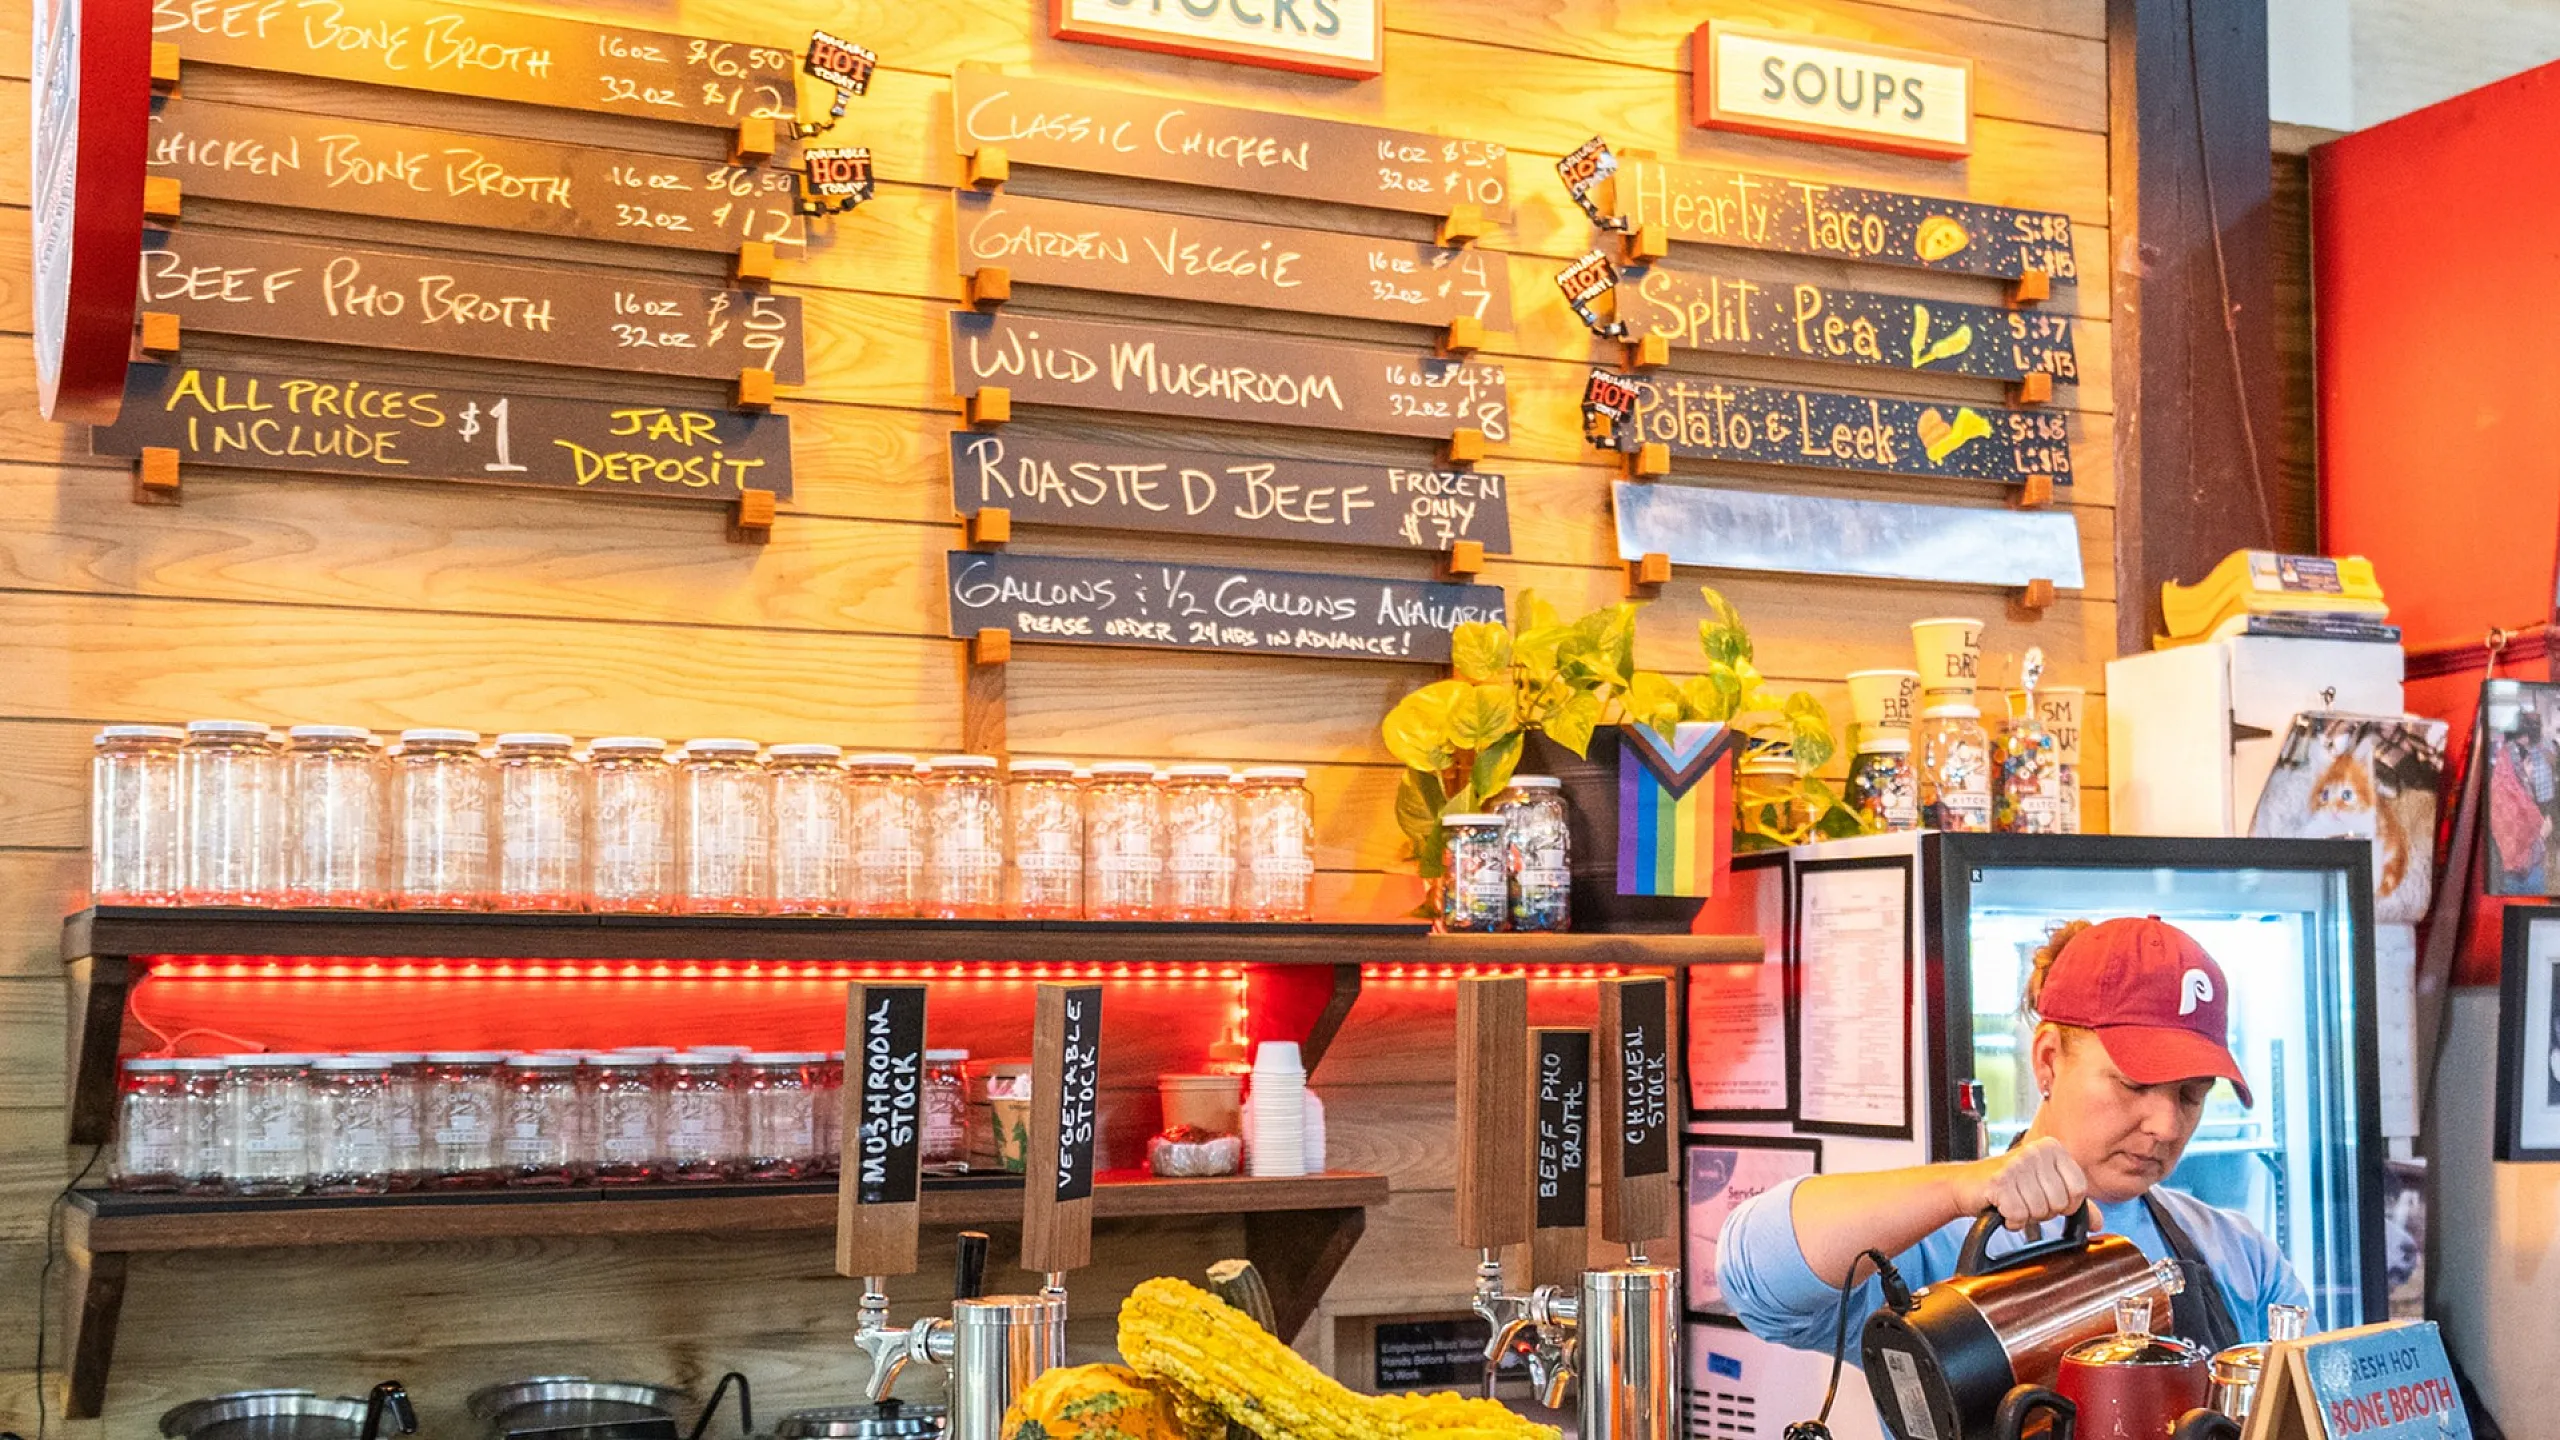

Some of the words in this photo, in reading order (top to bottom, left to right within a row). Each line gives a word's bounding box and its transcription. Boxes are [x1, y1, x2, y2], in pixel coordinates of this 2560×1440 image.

[297, 0, 410, 70] BONE
[424, 14, 552, 79] BROTH
[811, 40, 873, 81] HOT
[1762, 55, 1925, 120] SOUPS
[146, 116, 301, 177] HICKEN
[317, 134, 432, 192] BONE
[443, 148, 571, 208] BROTH
[966, 91, 1138, 153] CLASSIC
[1155, 109, 1309, 171] CHICKEN
[811, 158, 870, 184] HOT
[1635, 163, 1767, 244] Hearty
[1788, 180, 1886, 255] Taco
[968, 209, 1130, 264] GARDEN
[1143, 227, 1303, 288] VEGGIE
[1563, 259, 1609, 300] HOT
[140, 250, 302, 304] BEEF
[323, 256, 404, 316] PHO
[418, 275, 555, 332] BROTH
[1640, 271, 1759, 348] Split
[1794, 284, 1882, 361] Pea
[165, 370, 274, 413] ALL
[279, 378, 446, 427] PRICES
[970, 327, 1098, 384] WILD
[1110, 342, 1343, 411] MUSHROOM
[1590, 378, 1637, 412] HOT
[188, 416, 409, 464] INCLUDE
[609, 407, 722, 447] JAR
[1634, 381, 1752, 449] Potato
[1765, 410, 1792, 443] &
[1797, 394, 1898, 464] Leek
[966, 438, 1217, 516] ROASTED
[1226, 463, 1375, 525] BEEF
[1388, 469, 1500, 499] FROZEN
[1411, 498, 1476, 535] ONLY
[954, 561, 1117, 611] GALLONS
[1214, 575, 1356, 621] GALLONS
[1017, 612, 1093, 635] PLEASE
[1104, 619, 1178, 643] ORDER
[1266, 630, 1290, 646] IN
[1296, 628, 1411, 655] ADVANCE!
[2041, 701, 2073, 722] SM
[2178, 968, 2213, 1015] P
[863, 998, 890, 1183] MUSHROOM
[891, 1052, 917, 1147] STOCK
[1059, 998, 1082, 1188] VEGETABLE
[1077, 1046, 1095, 1143] STOCK
[1541, 1053, 1562, 1102] PHO
[1625, 1025, 1645, 1145] CHICKEN
[1647, 1052, 1666, 1129] STOCK
[1540, 1120, 1560, 1198] BEEF
[1562, 1081, 1583, 1172] BROTH
[1395, 1370, 1419, 1380] Work
[1414, 1355, 1444, 1365] Before
[2349, 1356, 2387, 1382] RESH
[2390, 1347, 2421, 1371] HOT
[2331, 1389, 2389, 1437] BONE
[2387, 1376, 2456, 1424] BROTH
